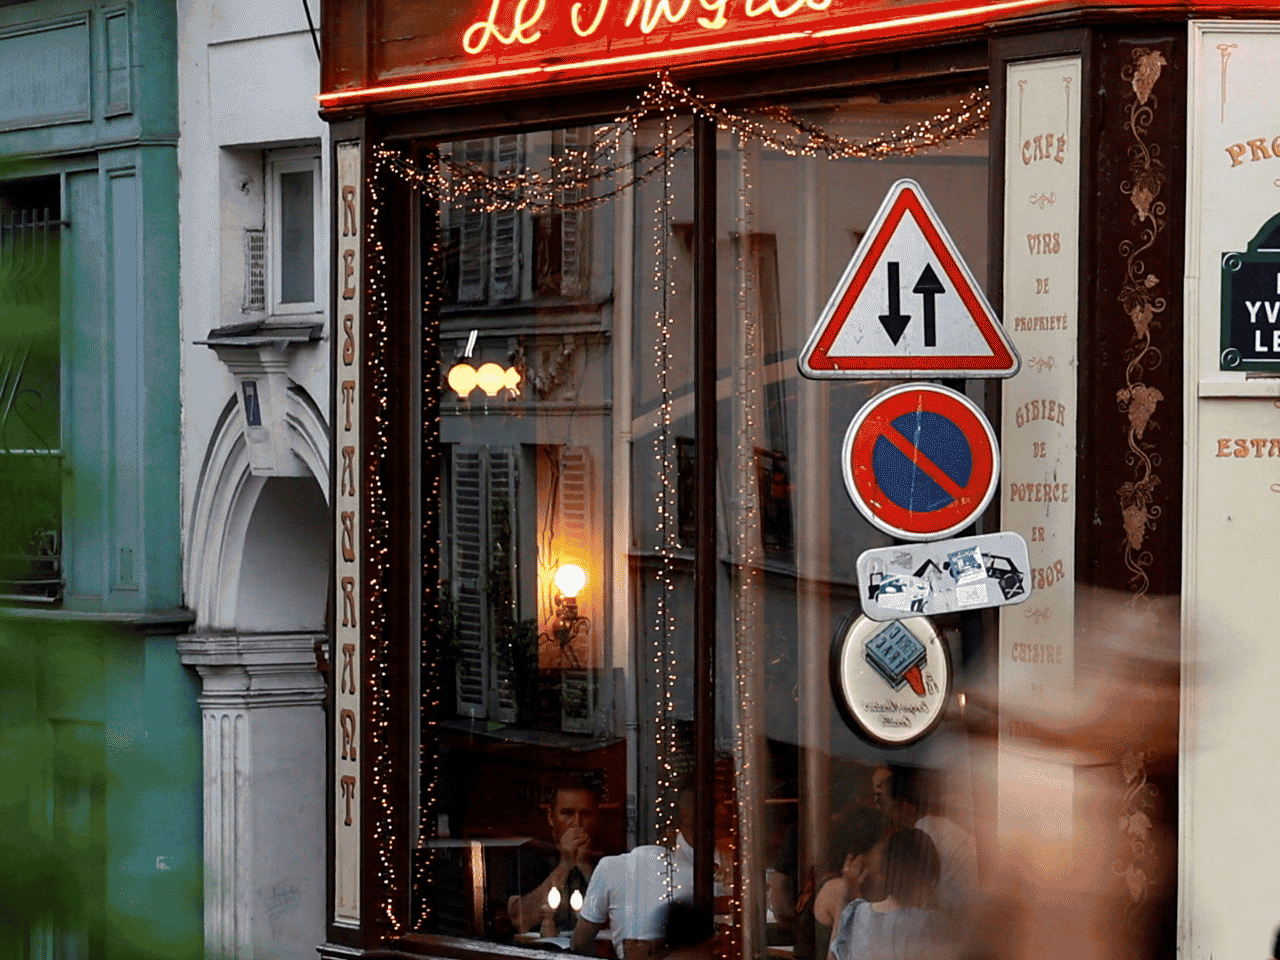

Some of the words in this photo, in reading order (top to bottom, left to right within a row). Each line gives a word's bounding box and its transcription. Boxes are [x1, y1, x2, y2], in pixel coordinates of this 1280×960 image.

[1022, 132, 1067, 166] CAFÉ
[1027, 233, 1061, 256] VINS
[1036, 278, 1050, 294] DE
[1015, 399, 1066, 428] GIBIER
[1033, 442, 1047, 458] DE
